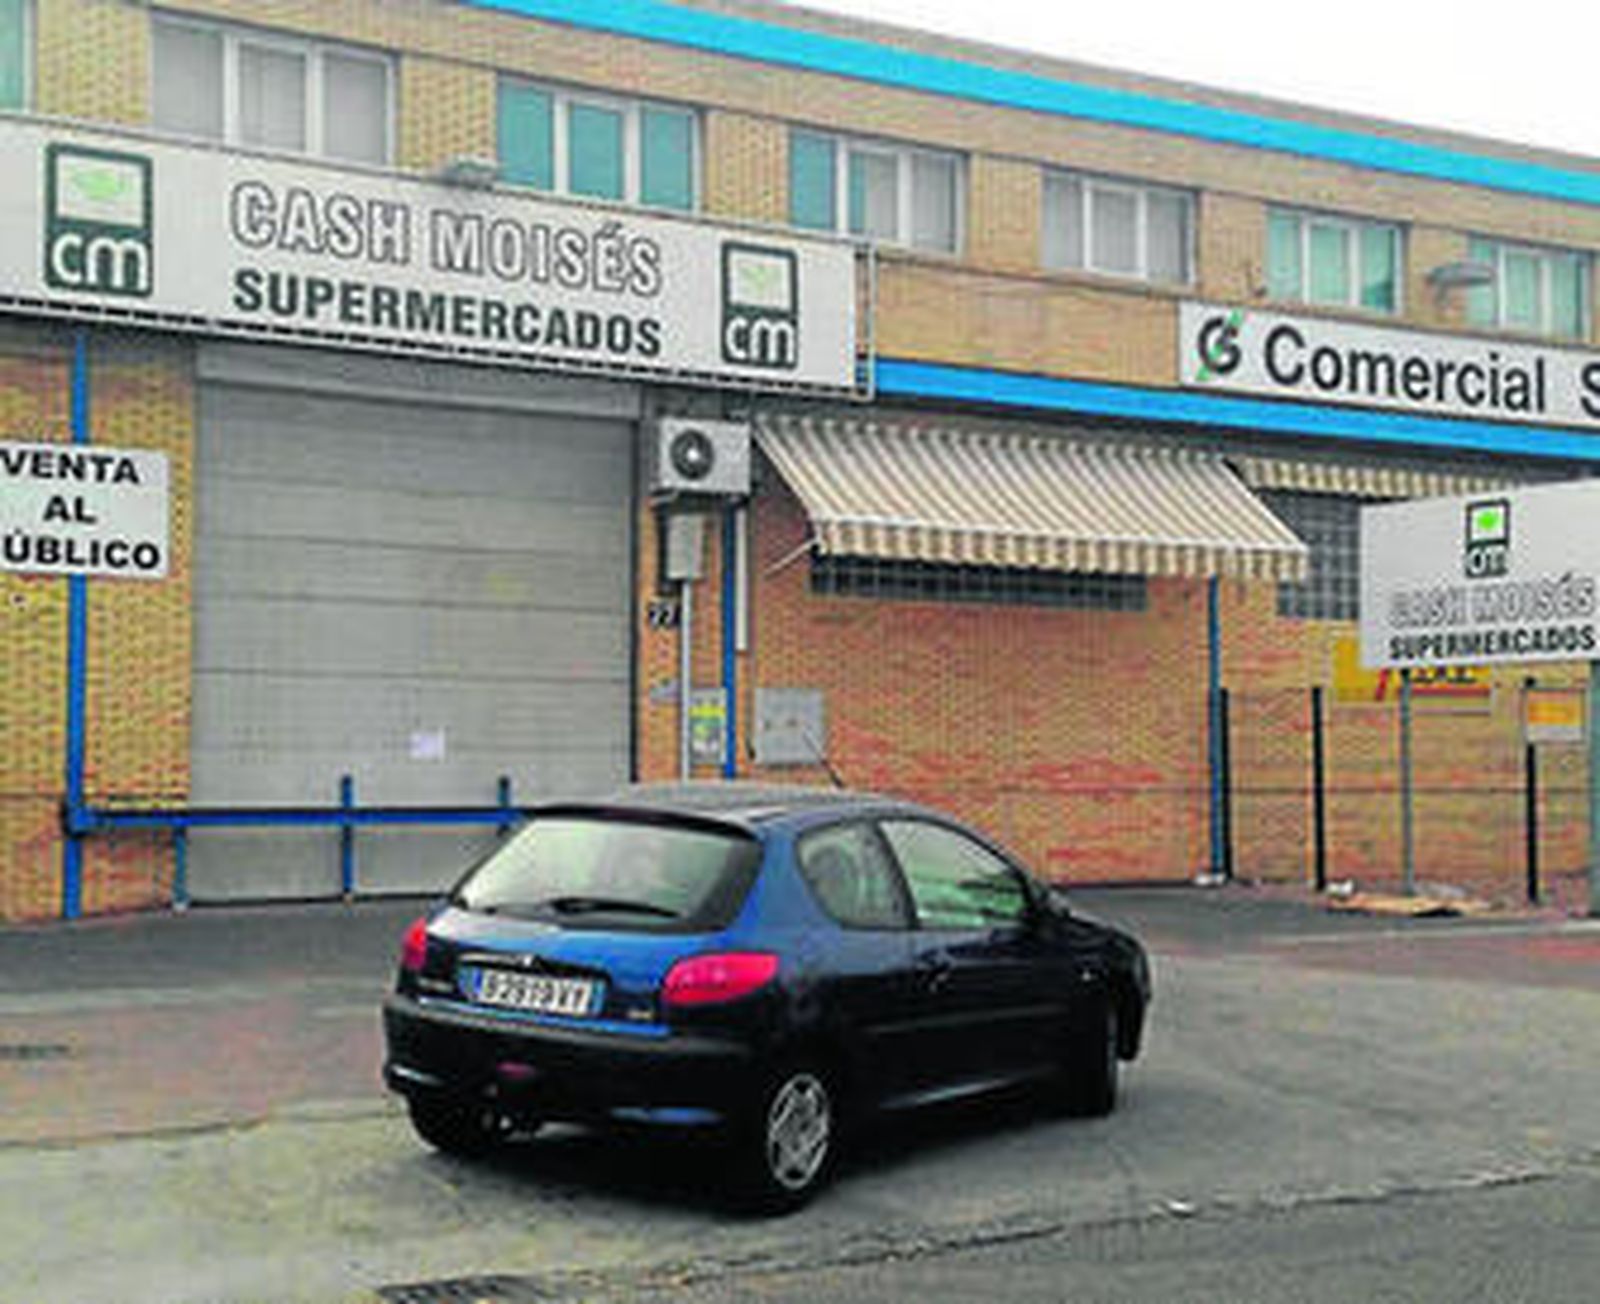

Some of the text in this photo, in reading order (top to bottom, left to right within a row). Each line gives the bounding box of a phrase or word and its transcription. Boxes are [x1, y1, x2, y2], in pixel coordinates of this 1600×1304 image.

[51, 232, 149, 290] cm
[229, 180, 661, 298] CASH MOISÉS
[233, 268, 661, 357] SUPERMERCADOS
[724, 316, 796, 366] cm
[1264, 324, 1545, 414] Comercial
[0, 449, 140, 485] VENTA
[43, 494, 97, 525] AL
[1388, 624, 1597, 660] SUPERMERCADOS
